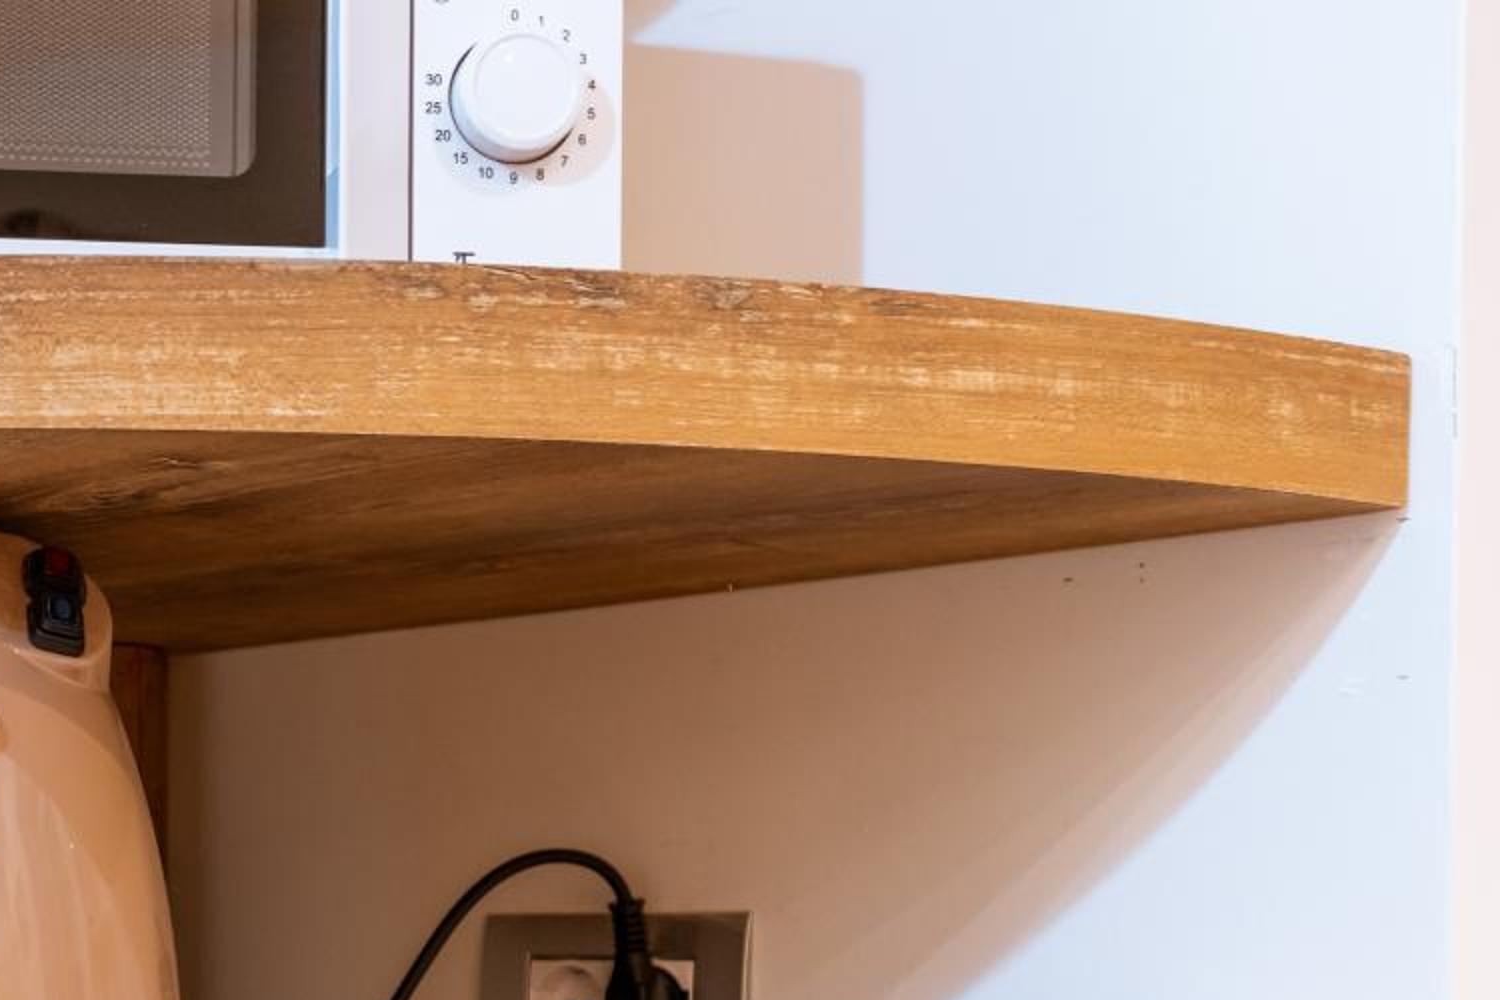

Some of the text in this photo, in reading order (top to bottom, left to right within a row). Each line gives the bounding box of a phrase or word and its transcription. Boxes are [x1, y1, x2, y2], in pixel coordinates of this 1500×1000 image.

[510, 9, 520, 22] 0
[538, 15, 545, 26] 1
[562, 29, 571, 42] 2
[579, 53, 588, 65] 3
[425, 73, 442, 86] 30
[587, 79, 596, 90] 4
[425, 101, 442, 115] 25
[586, 108, 596, 121] 5
[435, 129, 451, 142] 20
[577, 133, 587, 146] 6
[453, 152, 469, 165] 15
[560, 154, 570, 167] 7
[478, 166, 494, 180] 10
[509, 171, 519, 185] 9
[535, 168, 545, 181] 8
